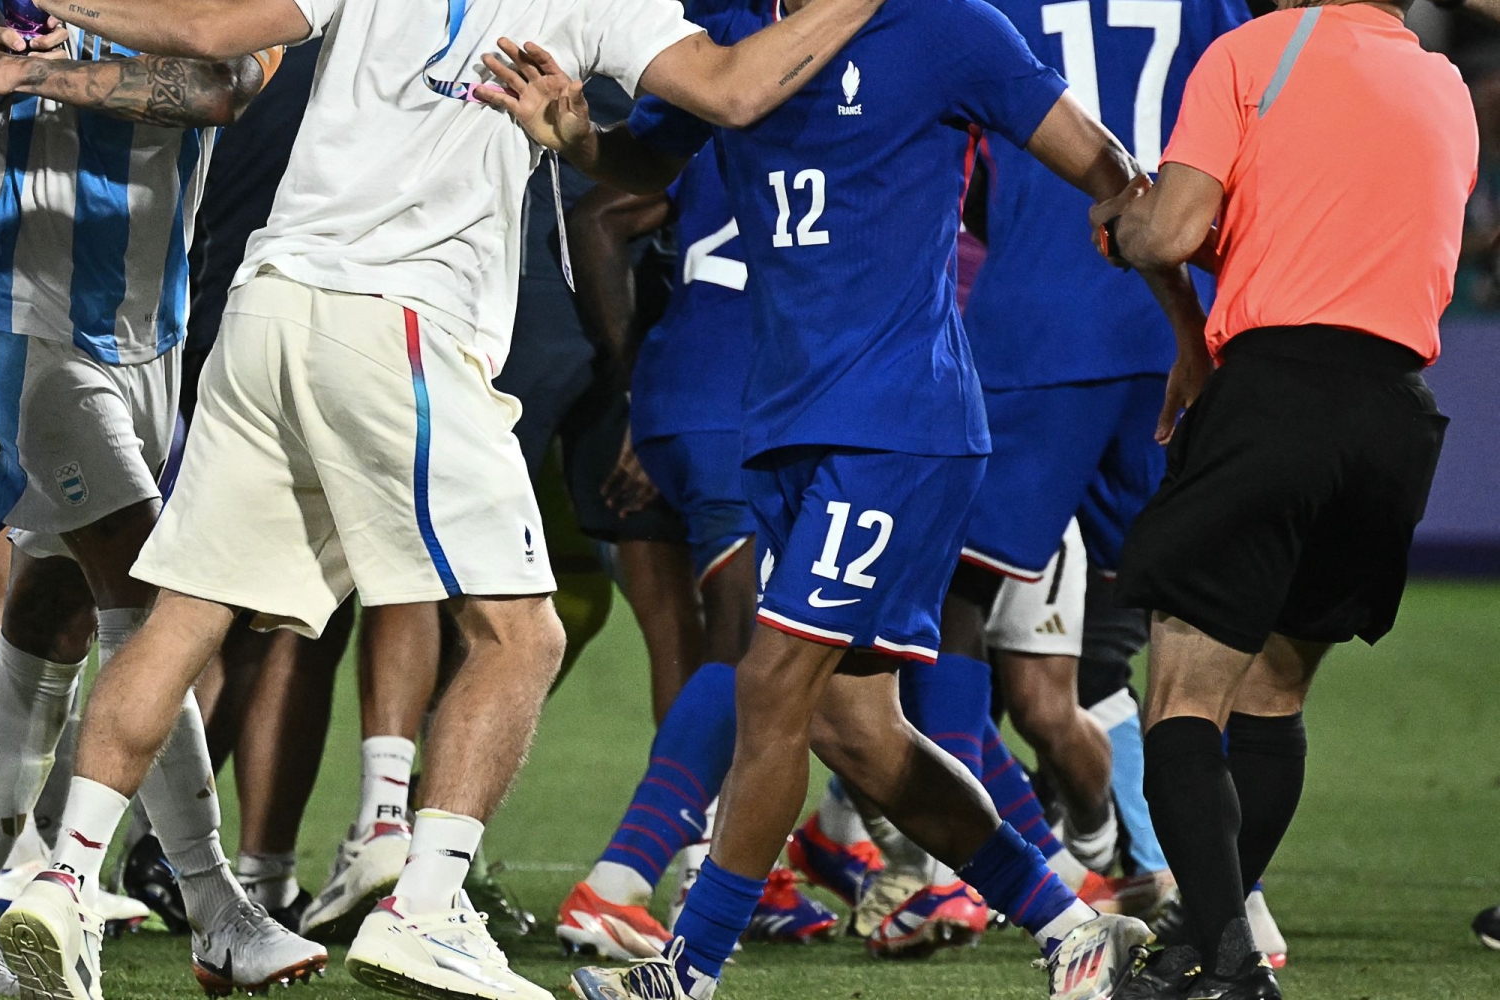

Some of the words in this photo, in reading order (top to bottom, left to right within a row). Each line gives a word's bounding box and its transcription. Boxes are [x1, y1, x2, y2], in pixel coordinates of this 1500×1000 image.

[837, 104, 862, 116] FRANCE
[768, 168, 830, 248] 12
[810, 500, 894, 589] 12
